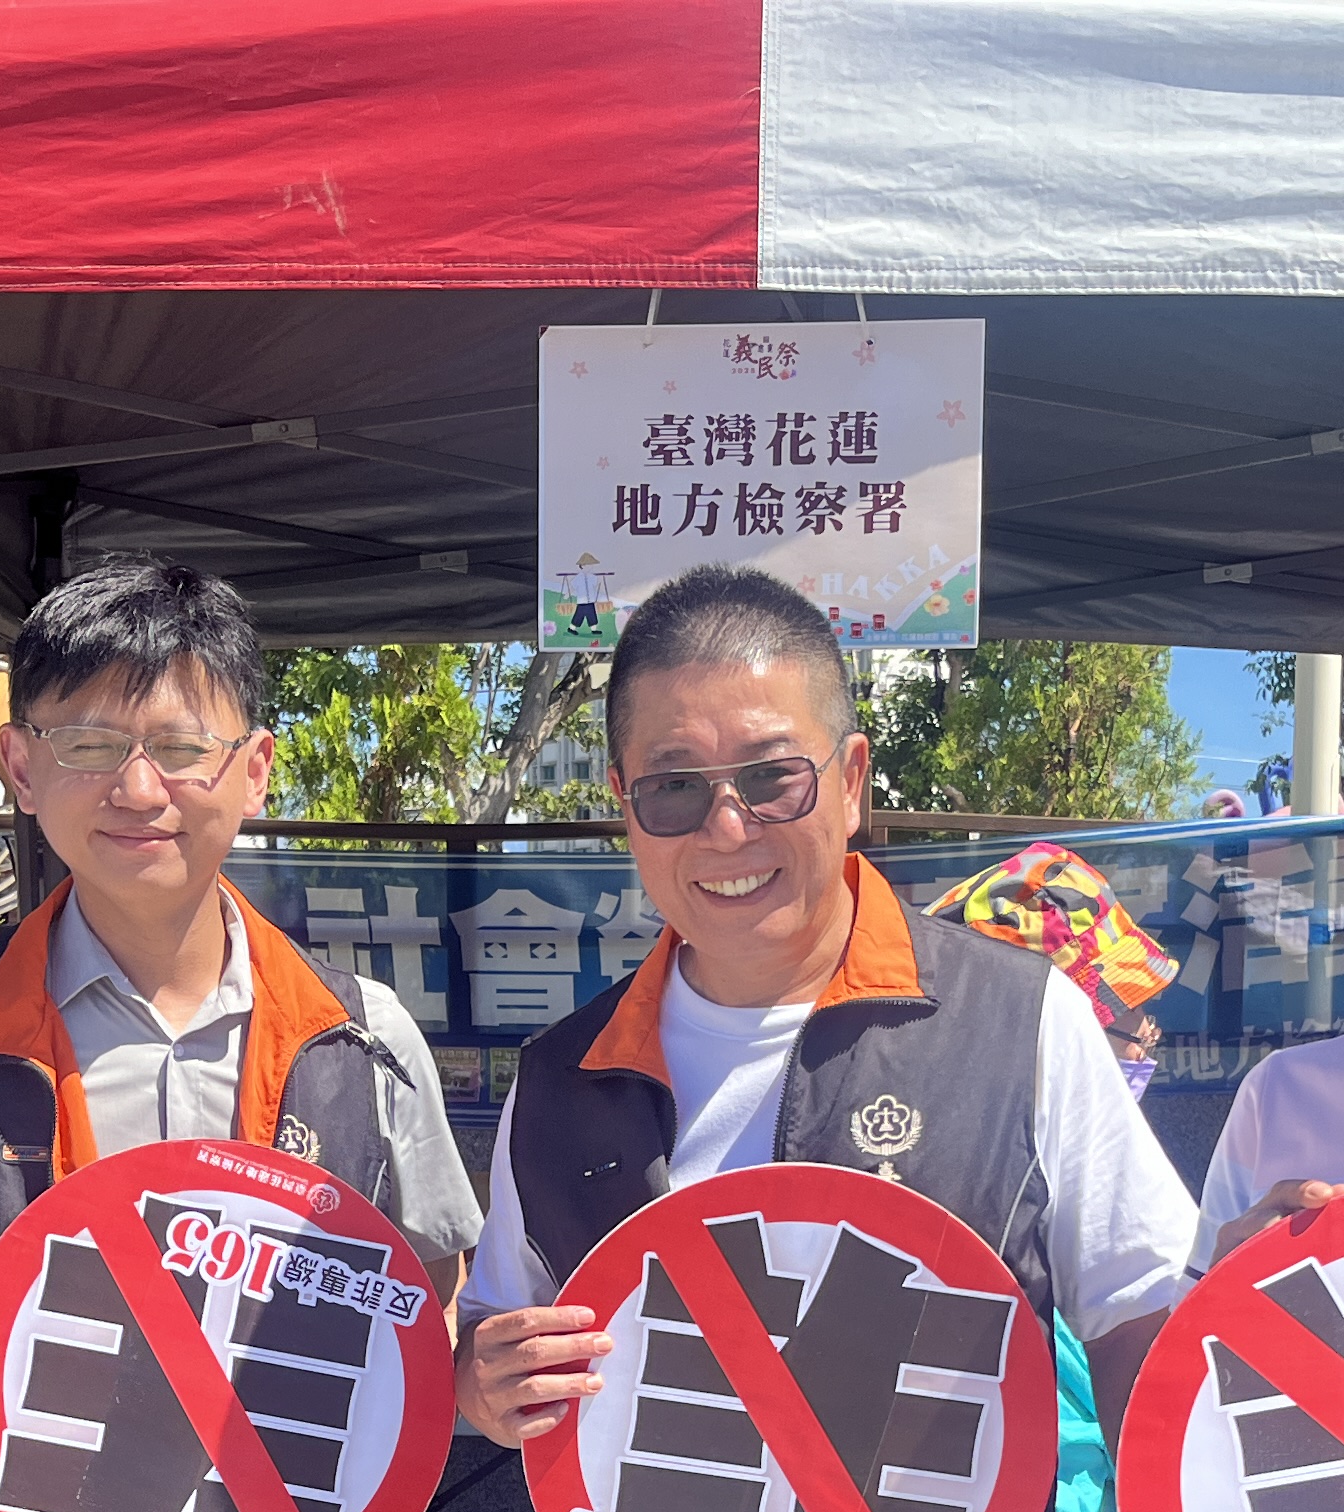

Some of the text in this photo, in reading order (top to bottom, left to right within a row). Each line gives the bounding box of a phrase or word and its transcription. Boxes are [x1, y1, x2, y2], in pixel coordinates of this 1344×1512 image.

[643, 411, 880, 467] 臺灣花蓮
[612, 481, 907, 537] 地方檢察署
[820, 543, 951, 600] HAKKA
